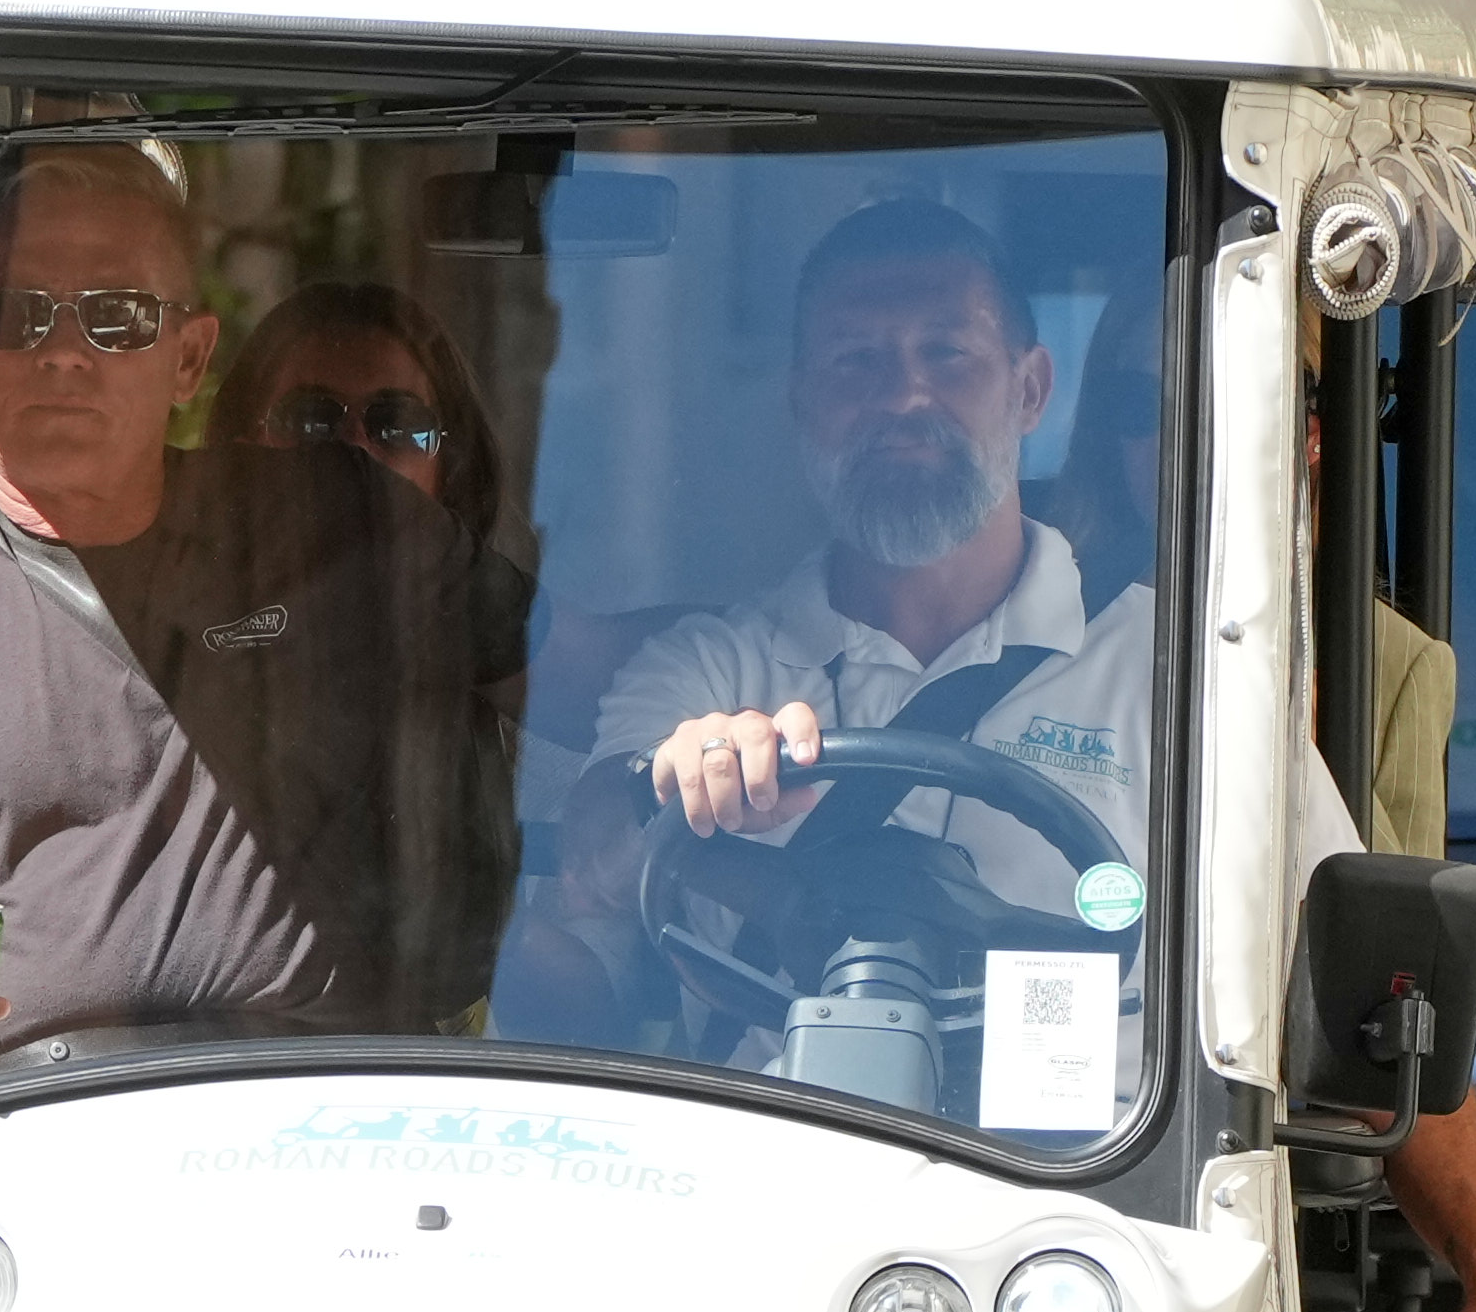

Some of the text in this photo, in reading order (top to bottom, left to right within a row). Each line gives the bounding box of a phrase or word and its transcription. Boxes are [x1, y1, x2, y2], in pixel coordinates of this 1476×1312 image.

[179, 1144, 698, 1198] ROMAN ROADS TOURS
